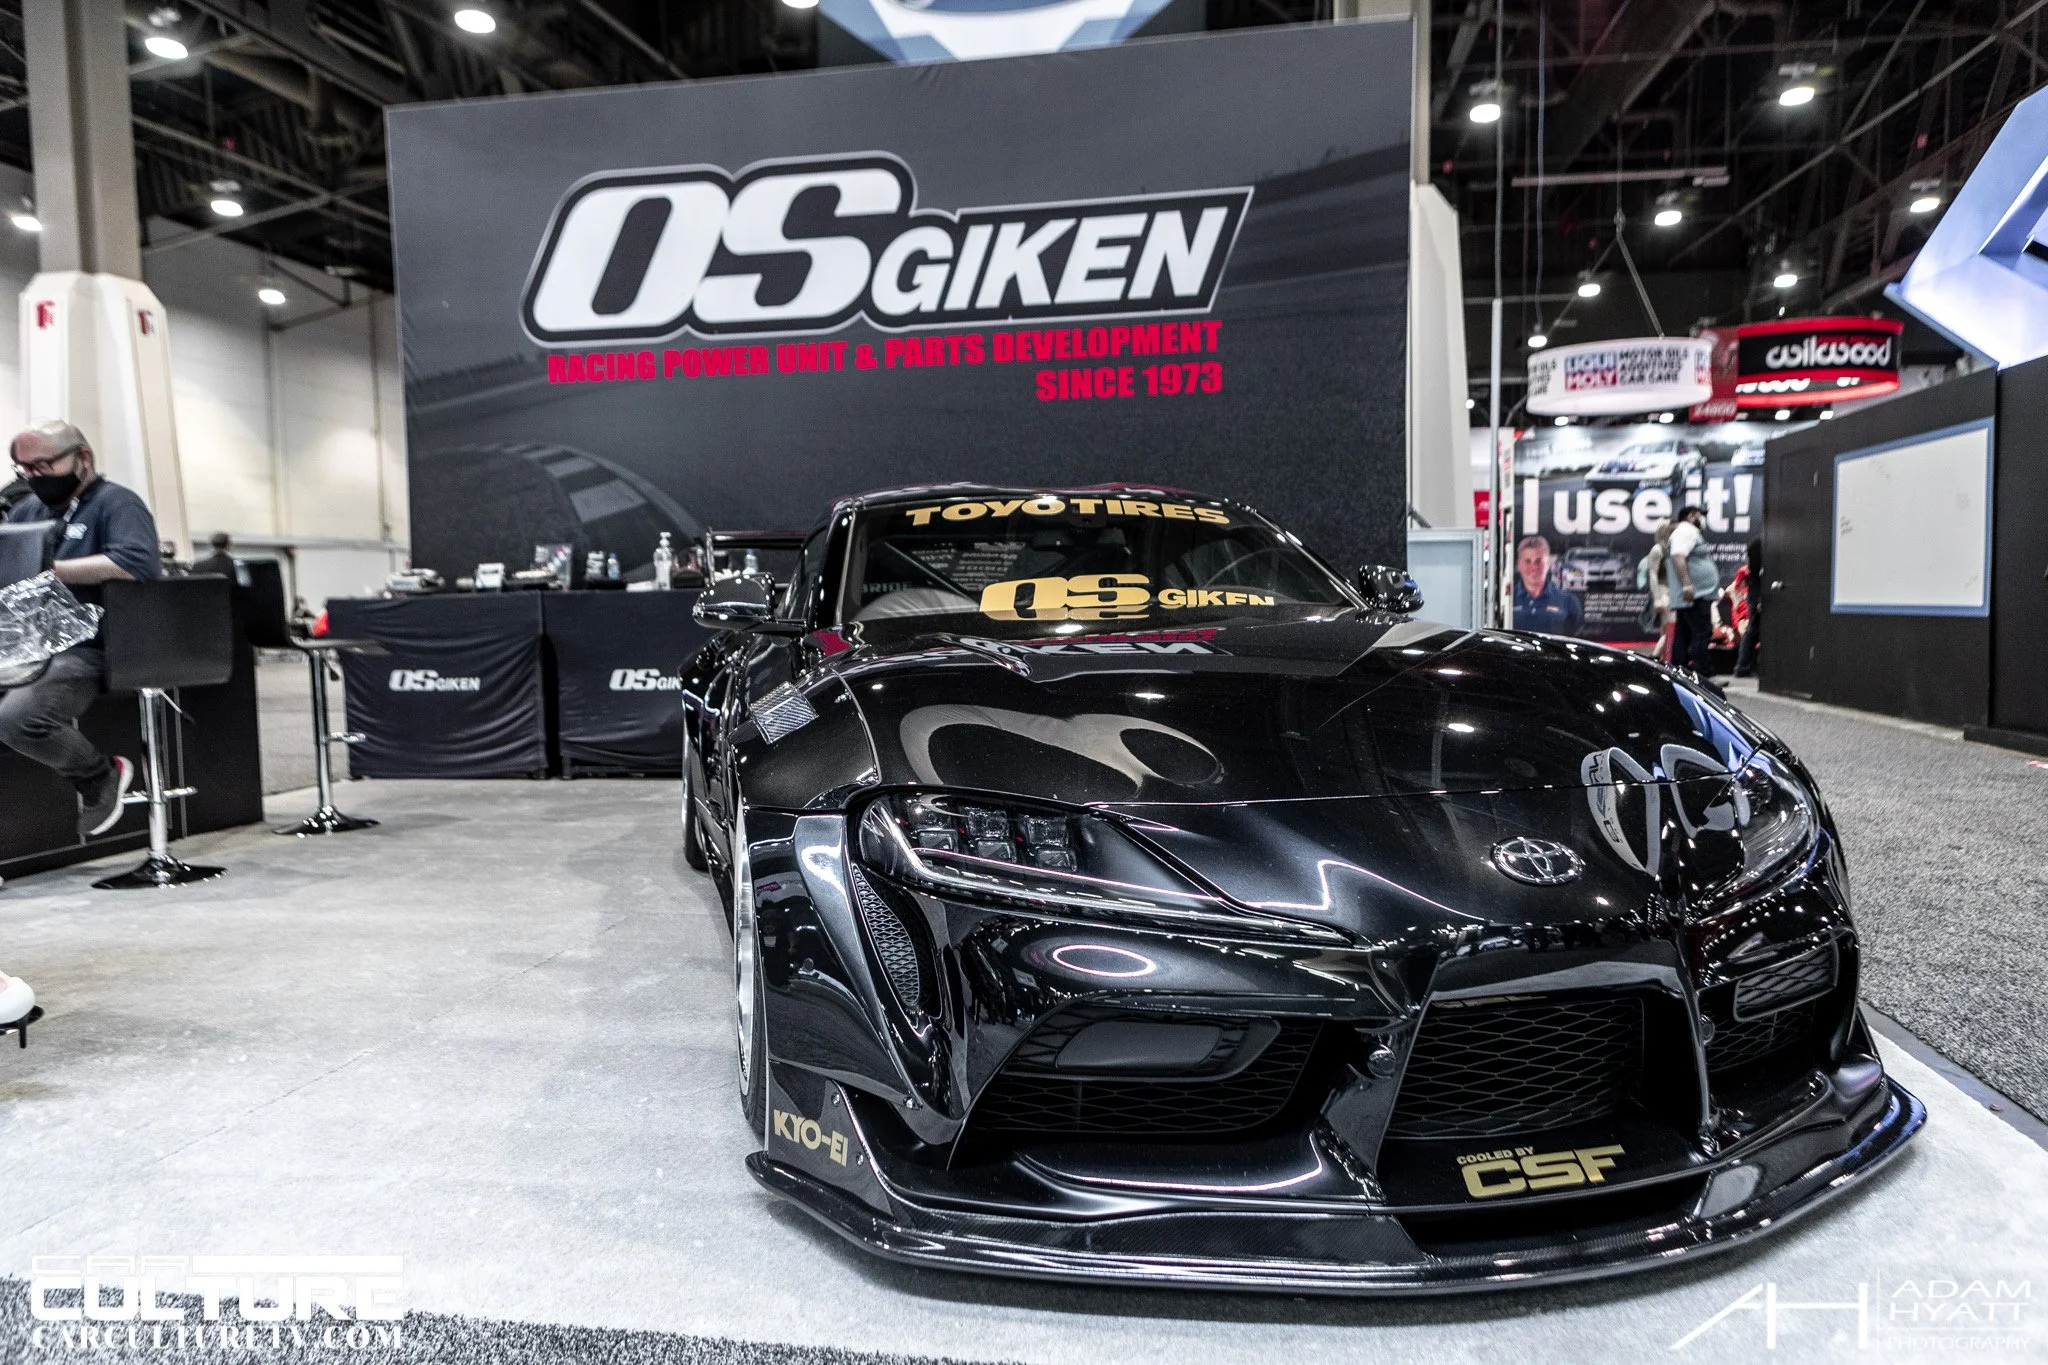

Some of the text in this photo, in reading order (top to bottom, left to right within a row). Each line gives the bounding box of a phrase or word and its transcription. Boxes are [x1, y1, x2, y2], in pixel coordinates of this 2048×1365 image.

[547, 320, 1223, 384] RACING POWER UNIT & PARTS DEVELOPMENT
[1765, 334, 1893, 370] wilwood
[1035, 361, 1223, 401] SINCE 1973
[1566, 370, 1617, 391] MOLY
[906, 499, 1230, 526] TOYO TIRES
[1523, 478, 1539, 535] I
[1553, 487, 1673, 535] use
[1457, 1146, 1535, 1166] COOLED BY
[1461, 1144, 1626, 1198] CSF
